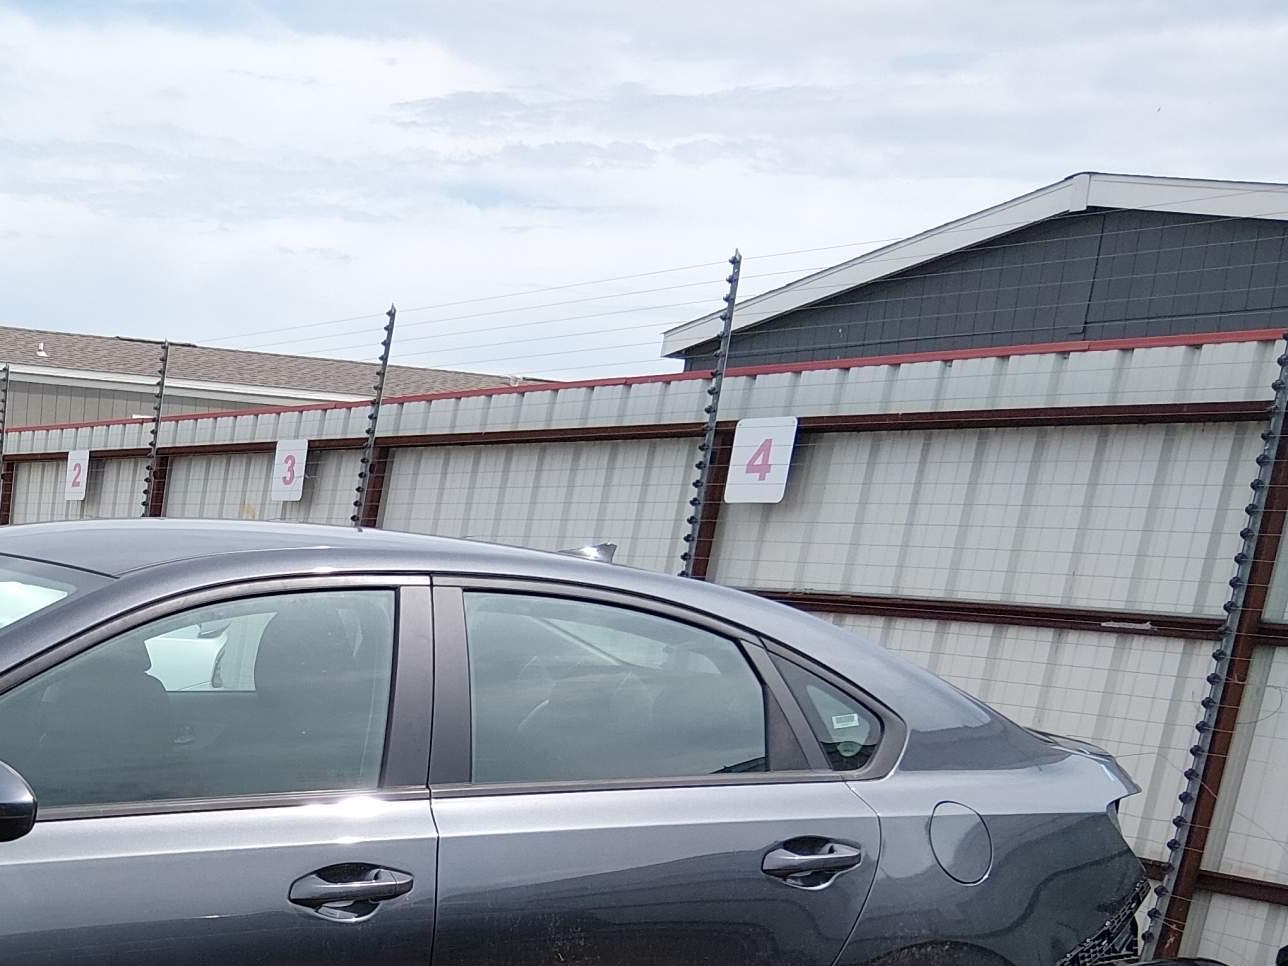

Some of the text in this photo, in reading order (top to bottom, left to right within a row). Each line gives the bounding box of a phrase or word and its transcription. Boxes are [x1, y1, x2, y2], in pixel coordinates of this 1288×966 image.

[71, 463, 82, 488] 2
[282, 454, 296, 486] 3
[745, 438, 773, 481] 4
